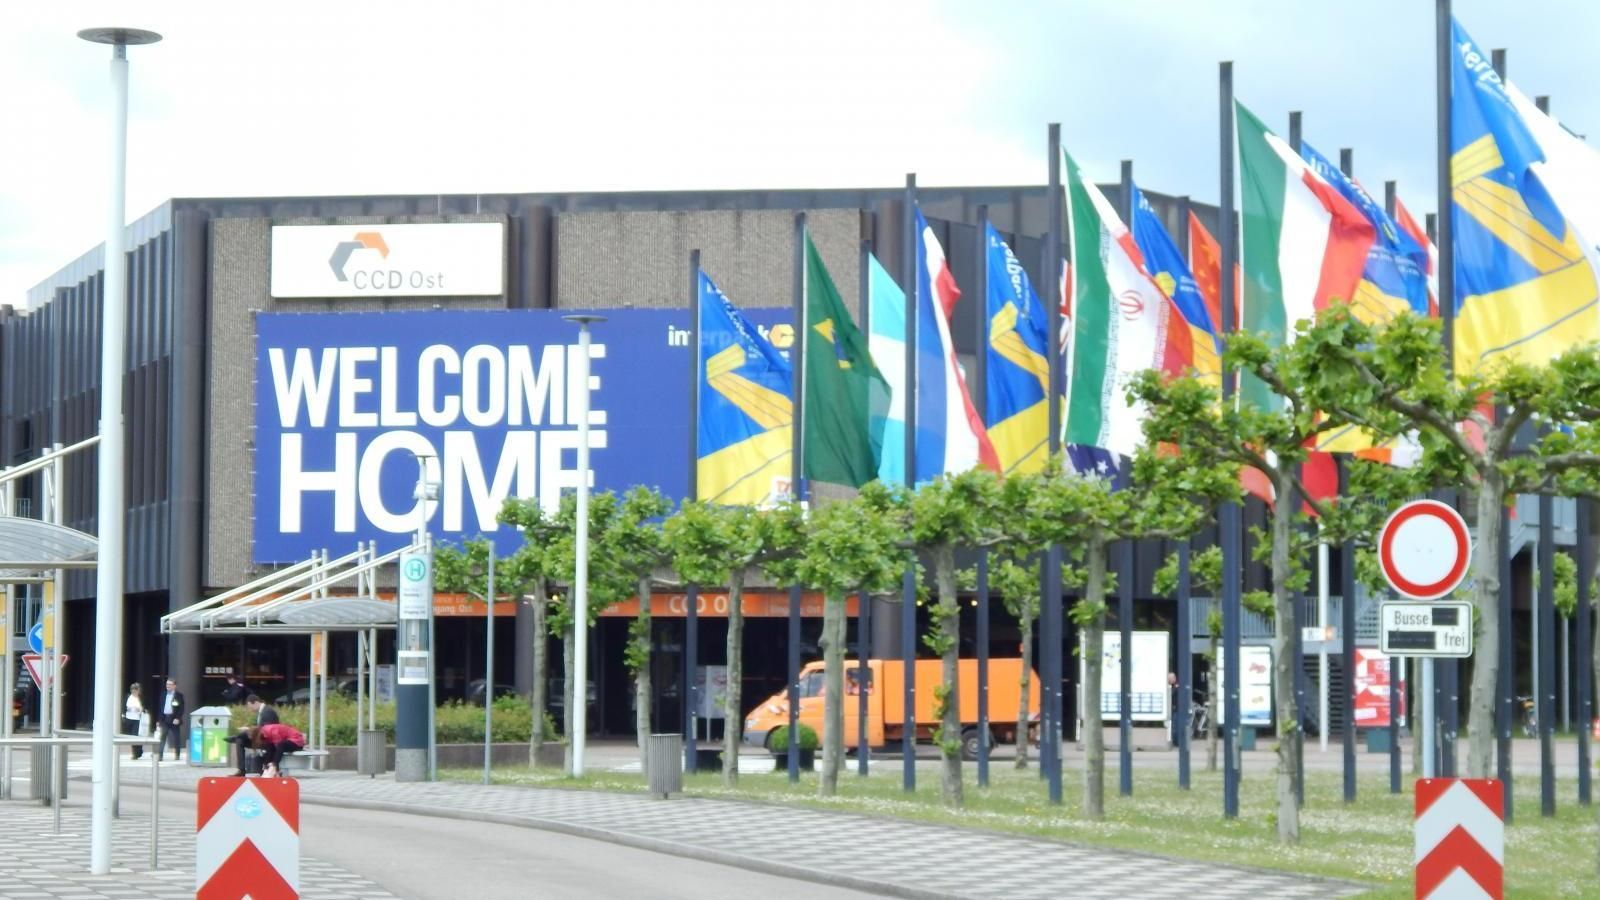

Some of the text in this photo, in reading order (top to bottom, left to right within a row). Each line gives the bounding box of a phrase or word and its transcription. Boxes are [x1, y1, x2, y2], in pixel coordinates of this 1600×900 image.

[353, 270, 444, 290] CCD Ost
[268, 344, 607, 428] WELCOME
[1394, 610, 1429, 625] Busse
[1443, 631, 1465, 647] frei
